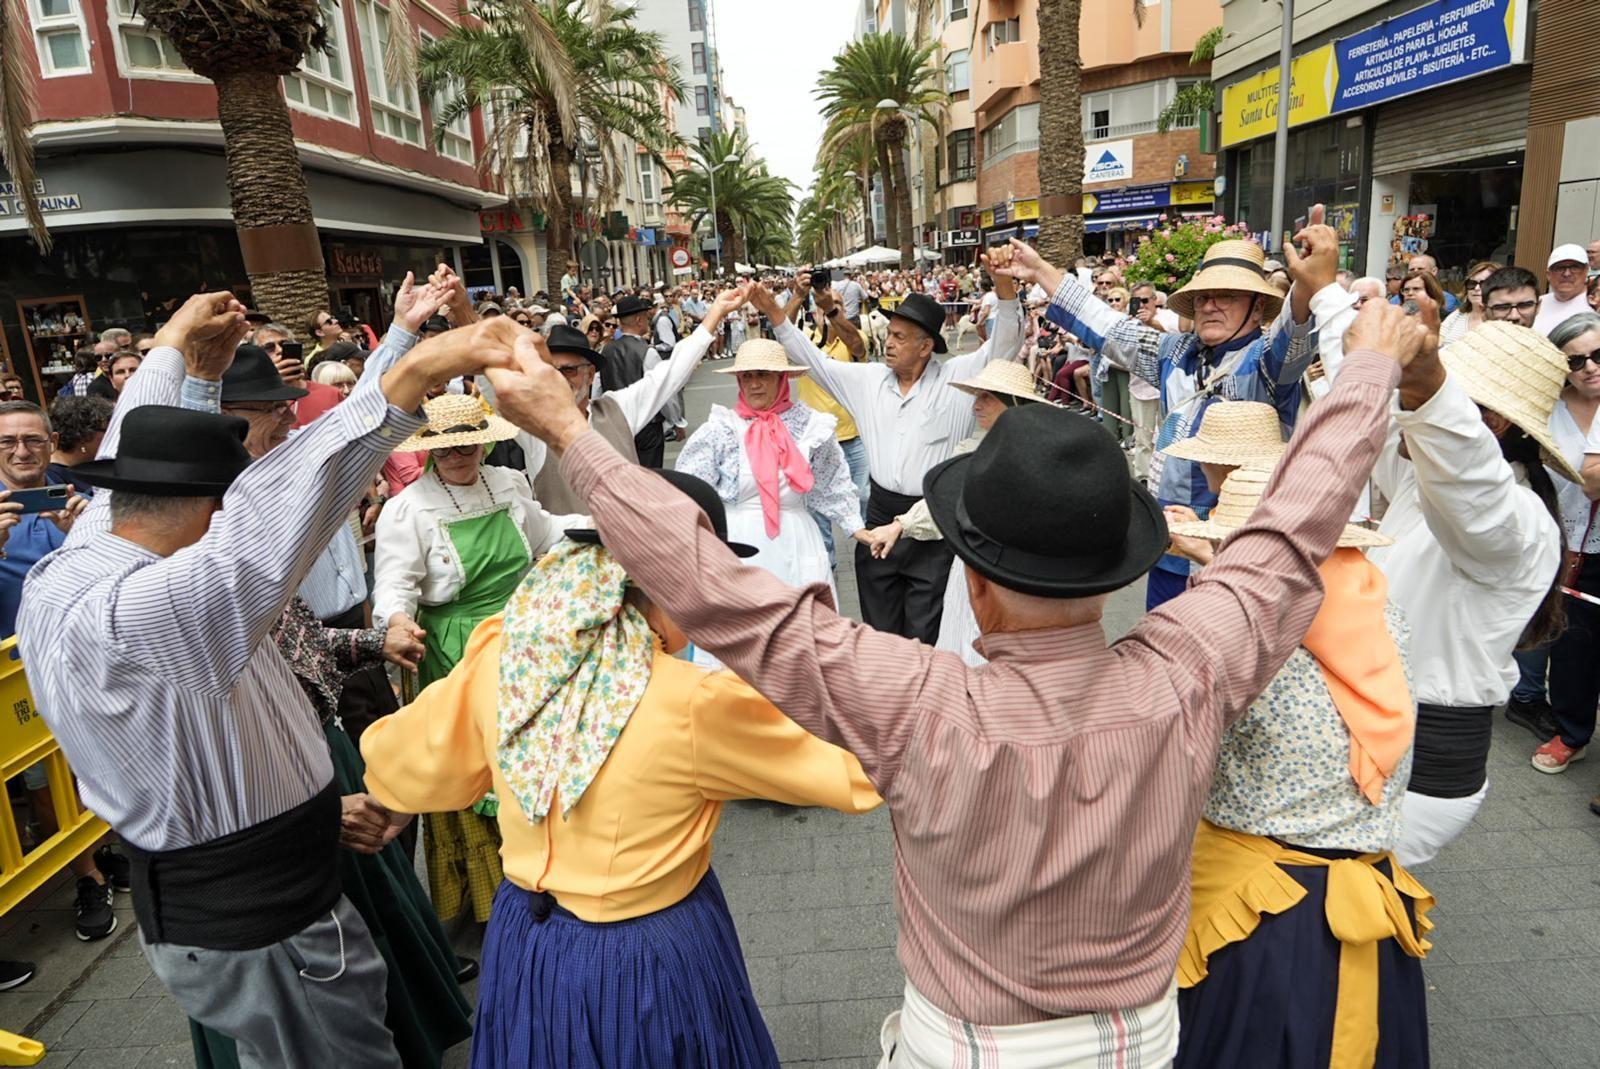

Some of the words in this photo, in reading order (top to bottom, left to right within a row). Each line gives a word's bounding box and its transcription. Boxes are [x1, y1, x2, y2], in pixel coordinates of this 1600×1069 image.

[1348, 36, 1389, 60] FERRETERÍA
[1354, 62, 1392, 83] ARTICULOS
[1394, 58, 1404, 71] DE
[1432, 33, 1476, 58] JUGUETES
[1365, 44, 1404, 67] ARTICULOS
[1405, 37, 1425, 53] PARA
[1427, 33, 1437, 46] EL
[1438, 21, 1468, 41] HOGAR
[1343, 78, 1384, 99] ACCESORIOS
[1386, 67, 1417, 87] MÓVILES
[1423, 51, 1465, 75] BISUTERÍA
[1247, 76, 1296, 104] MULTITIEA
[1265, 94, 1304, 119] Caina
[16, 196, 79, 213] CALINA
